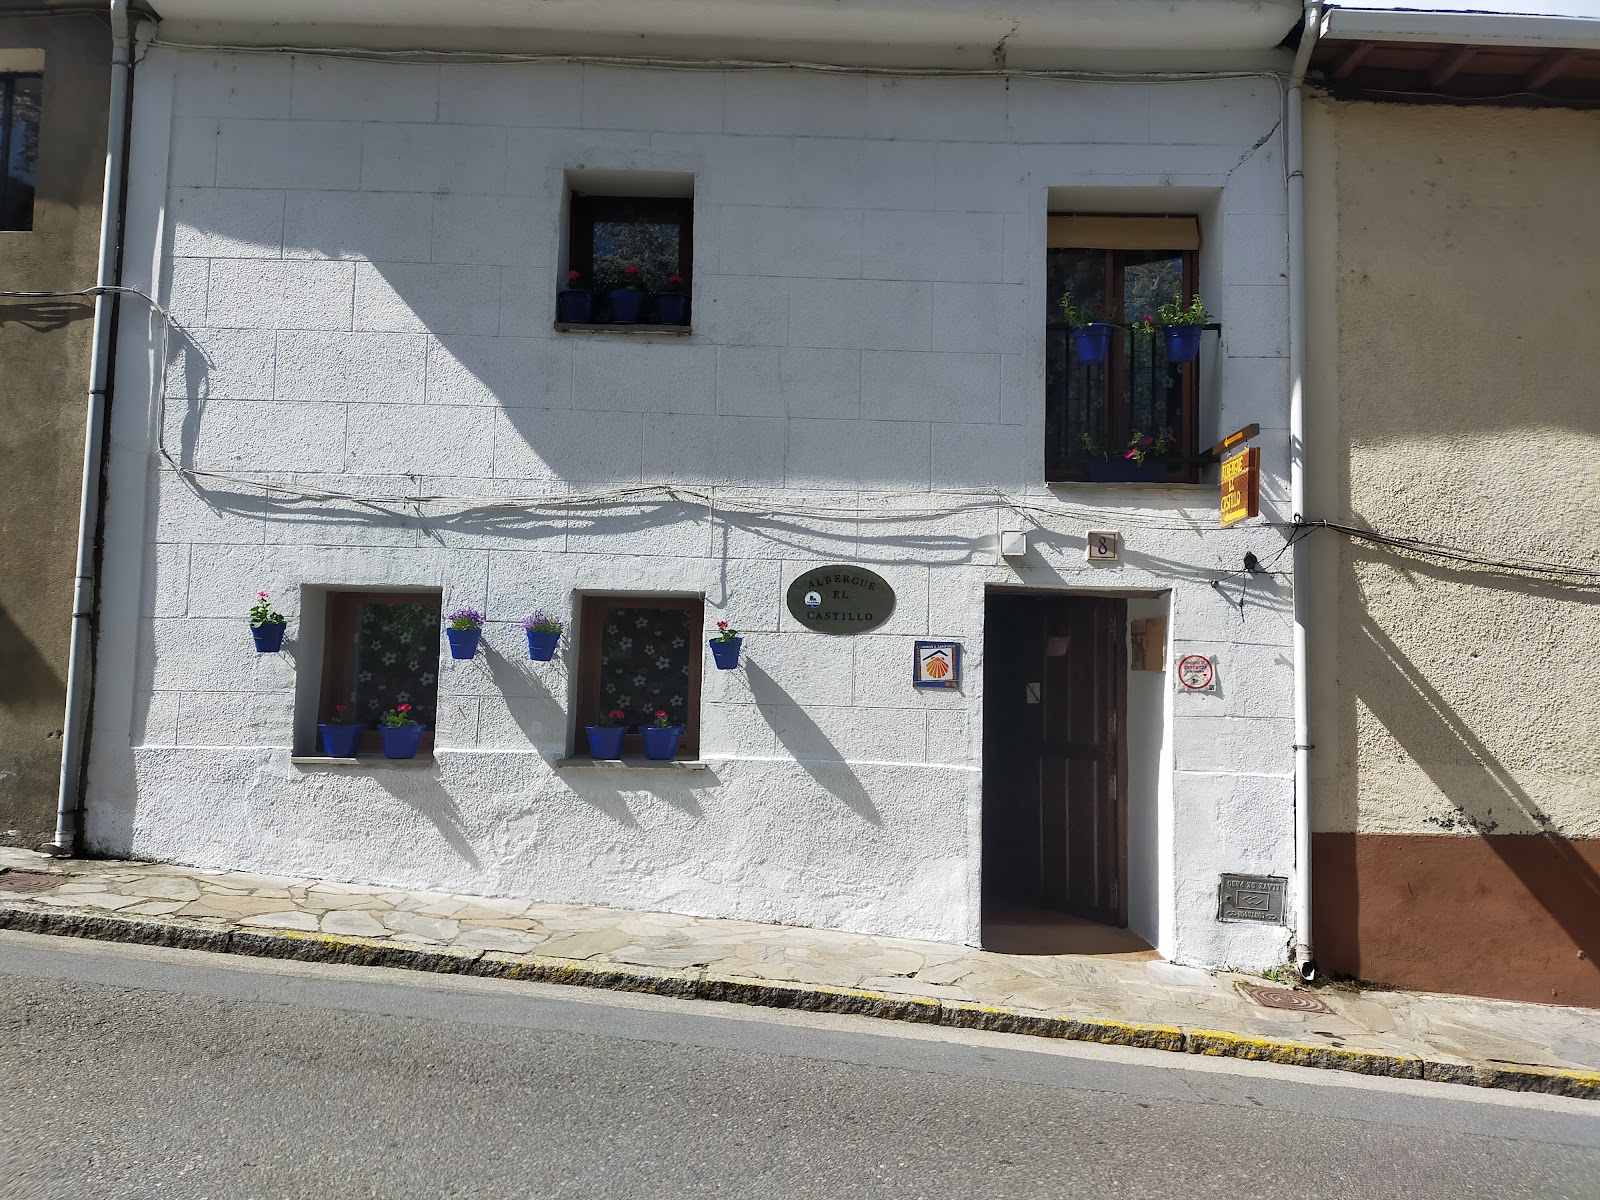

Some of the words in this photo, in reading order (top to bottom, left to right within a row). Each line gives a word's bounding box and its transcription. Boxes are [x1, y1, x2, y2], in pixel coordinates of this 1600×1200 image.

[1098, 536, 1108, 555] 8
[808, 574, 876, 591] ALBERGUE
[833, 591, 849, 599] EL
[807, 611, 873, 621] CASTILLO
